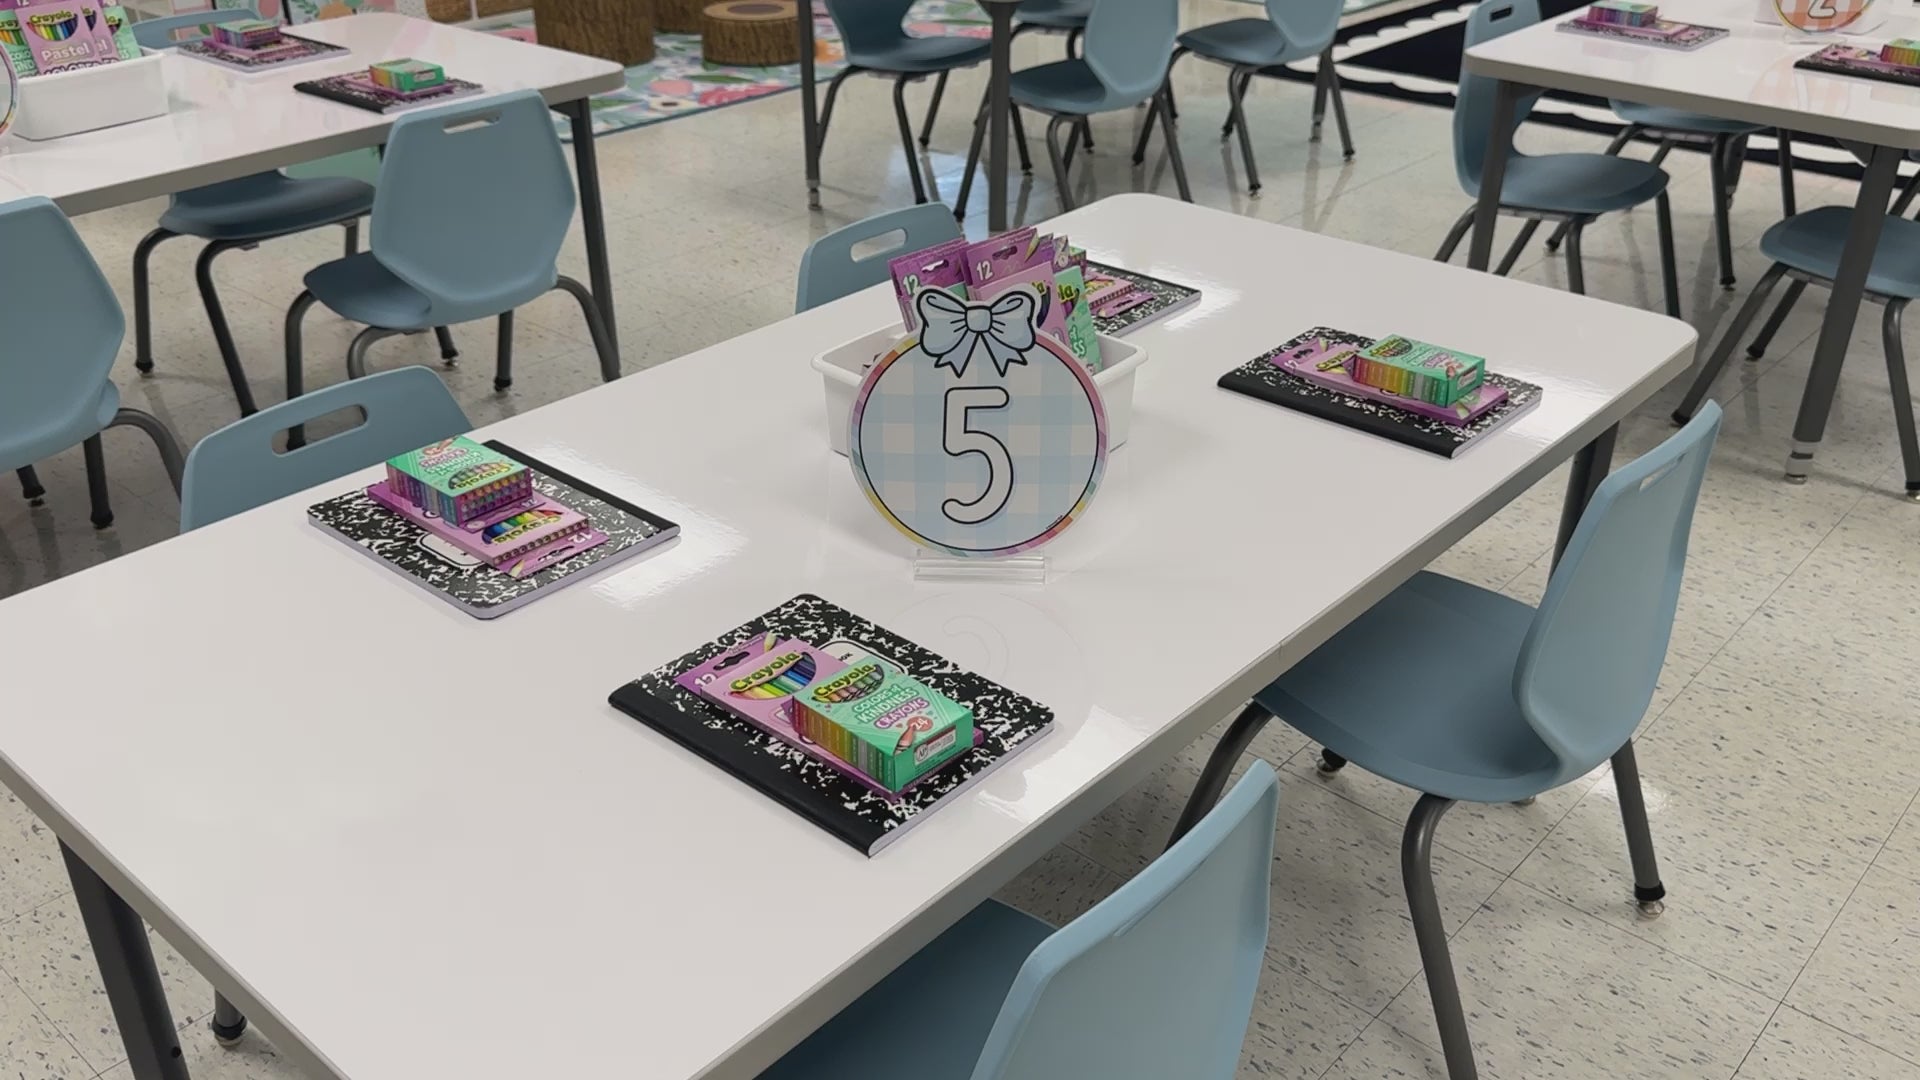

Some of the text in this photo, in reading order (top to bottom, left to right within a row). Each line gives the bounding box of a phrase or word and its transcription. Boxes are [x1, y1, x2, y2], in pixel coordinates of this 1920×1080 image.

[29, 10, 74, 24] Crayola
[40, 42, 90, 61] Pastel
[976, 261, 993, 281] 12
[941, 386, 1014, 524] 5
[492, 516, 562, 544] Crayola
[568, 531, 593, 544] 12
[730, 651, 802, 692] Crayola
[814, 664, 876, 696] Crayola
[853, 689, 893, 713] COLORS
[857, 687, 919, 723] KINDNESS
[875, 697, 930, 729] CRAYONS
[910, 718, 929, 730] 24
